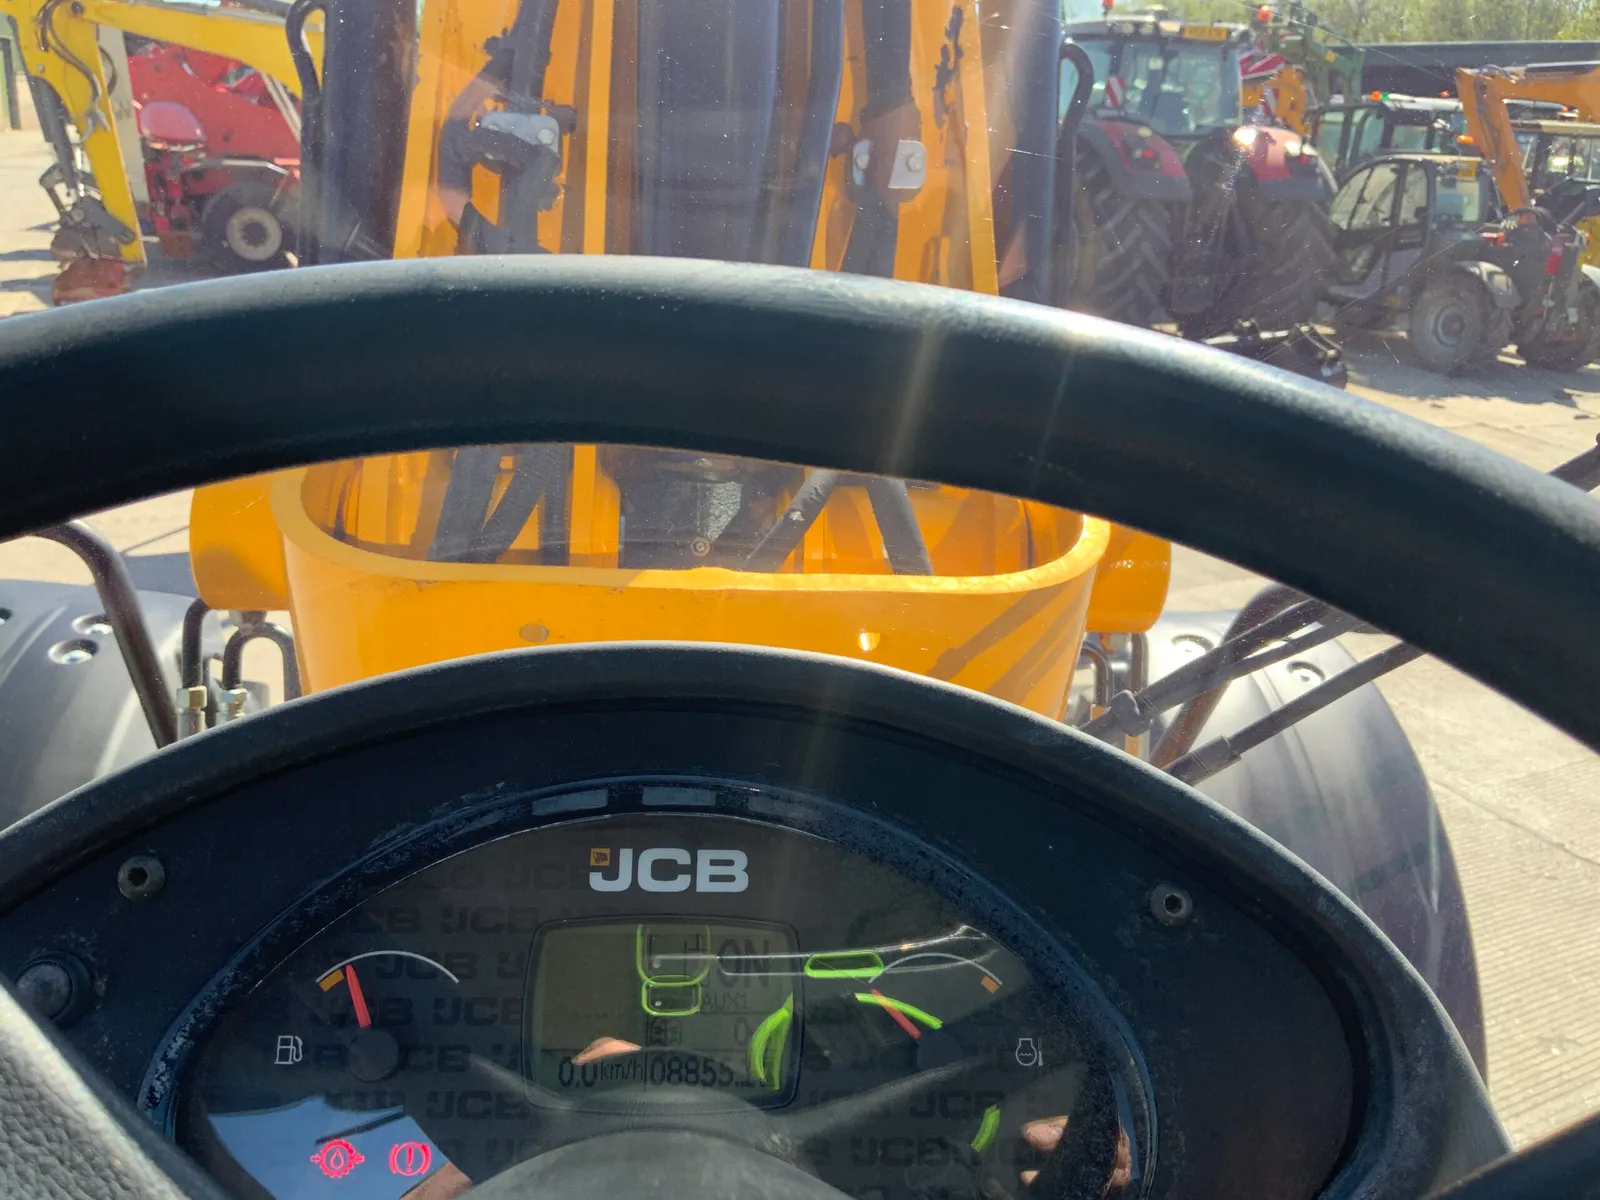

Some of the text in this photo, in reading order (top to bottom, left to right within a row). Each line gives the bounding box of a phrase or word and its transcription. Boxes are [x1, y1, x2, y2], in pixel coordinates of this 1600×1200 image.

[589, 849, 749, 892] JCB
[718, 938, 771, 988] ON
[558, 1055, 643, 1087] 0.0 km/h
